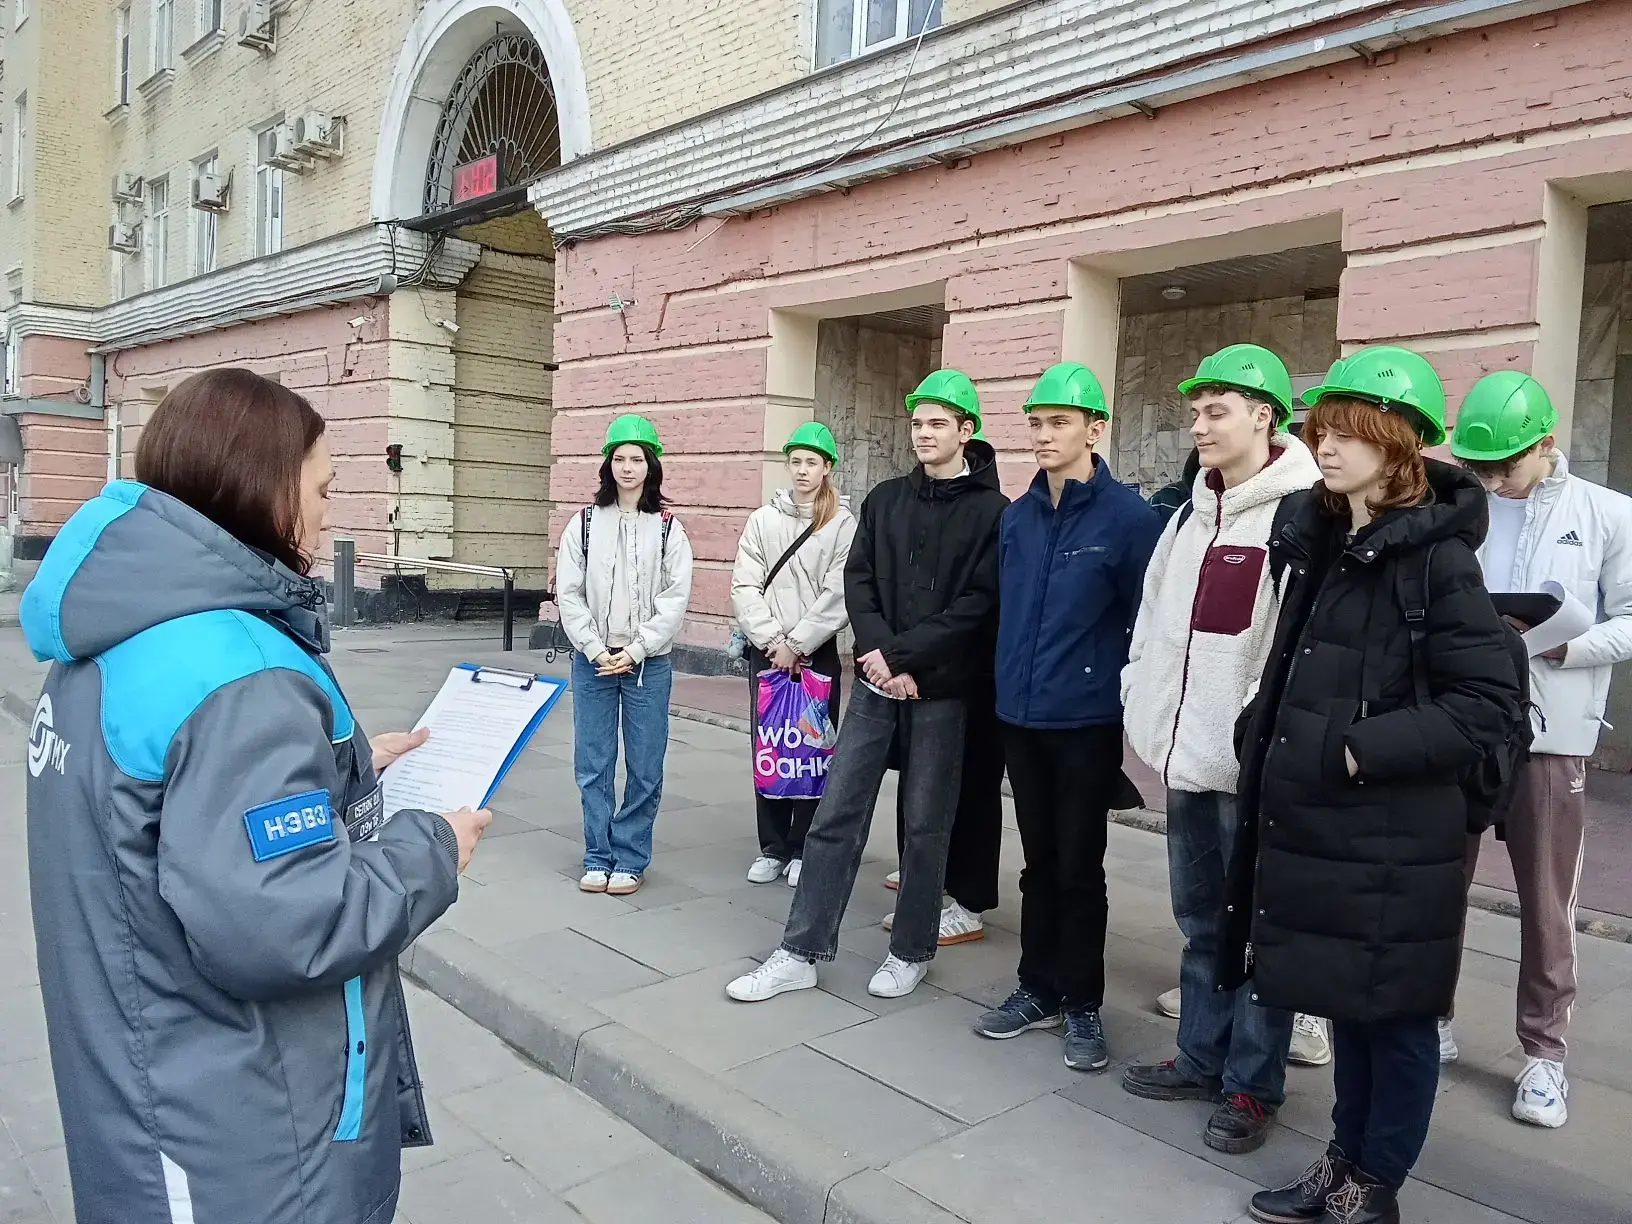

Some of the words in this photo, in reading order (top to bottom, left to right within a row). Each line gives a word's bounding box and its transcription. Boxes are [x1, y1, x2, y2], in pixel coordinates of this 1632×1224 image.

[757, 718, 802, 749] wb
[756, 747, 833, 778] банк
[263, 804, 327, 841] НЭВЗ
